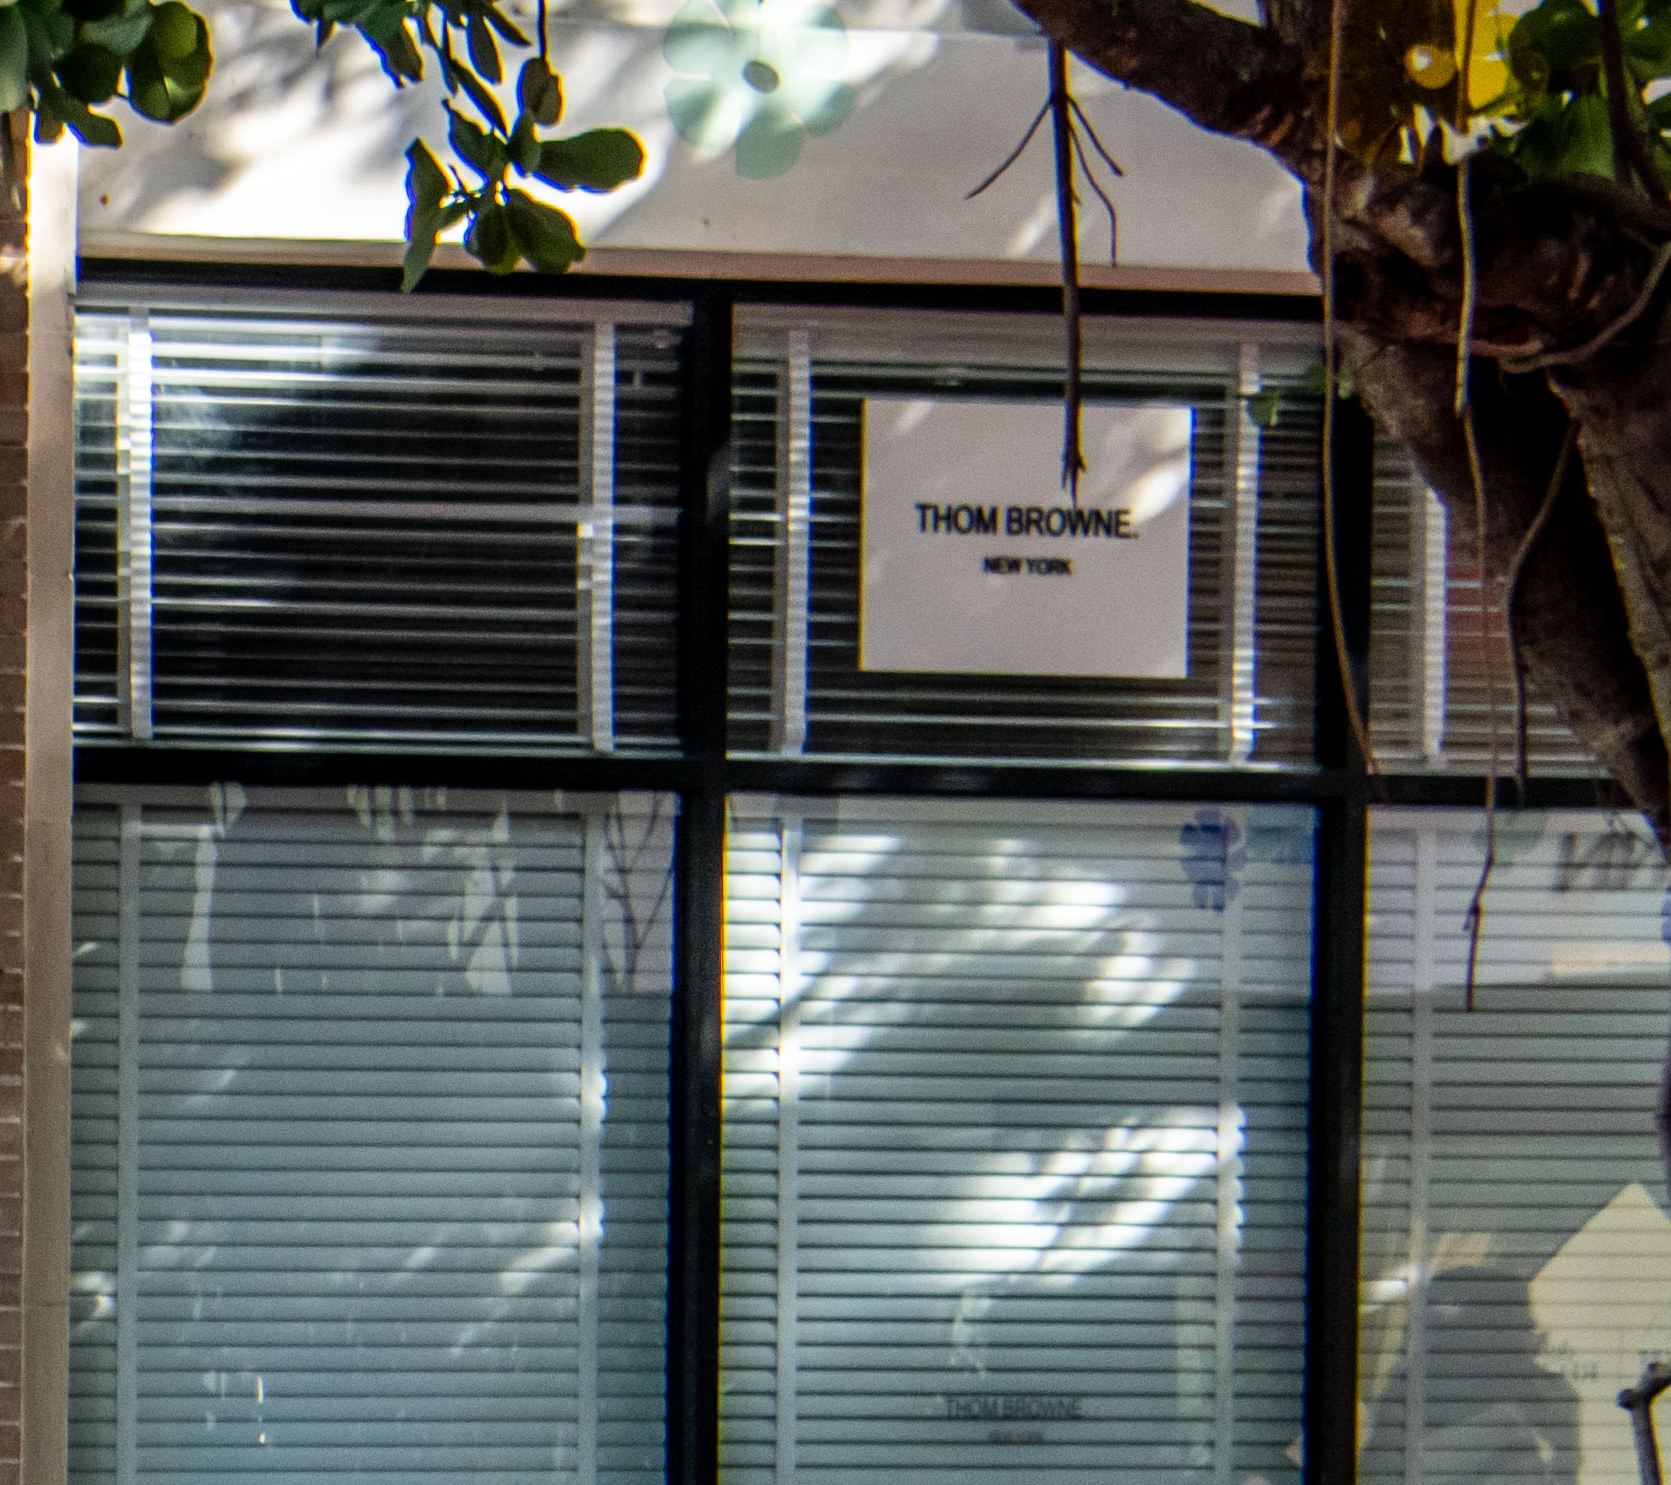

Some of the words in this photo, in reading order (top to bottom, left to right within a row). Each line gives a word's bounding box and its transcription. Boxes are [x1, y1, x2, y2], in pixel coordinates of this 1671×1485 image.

[916, 503, 997, 535] THOM
[1006, 507, 1140, 539] BROWNE.
[983, 556, 1023, 575] NEW
[1027, 557, 1072, 577] YORK
